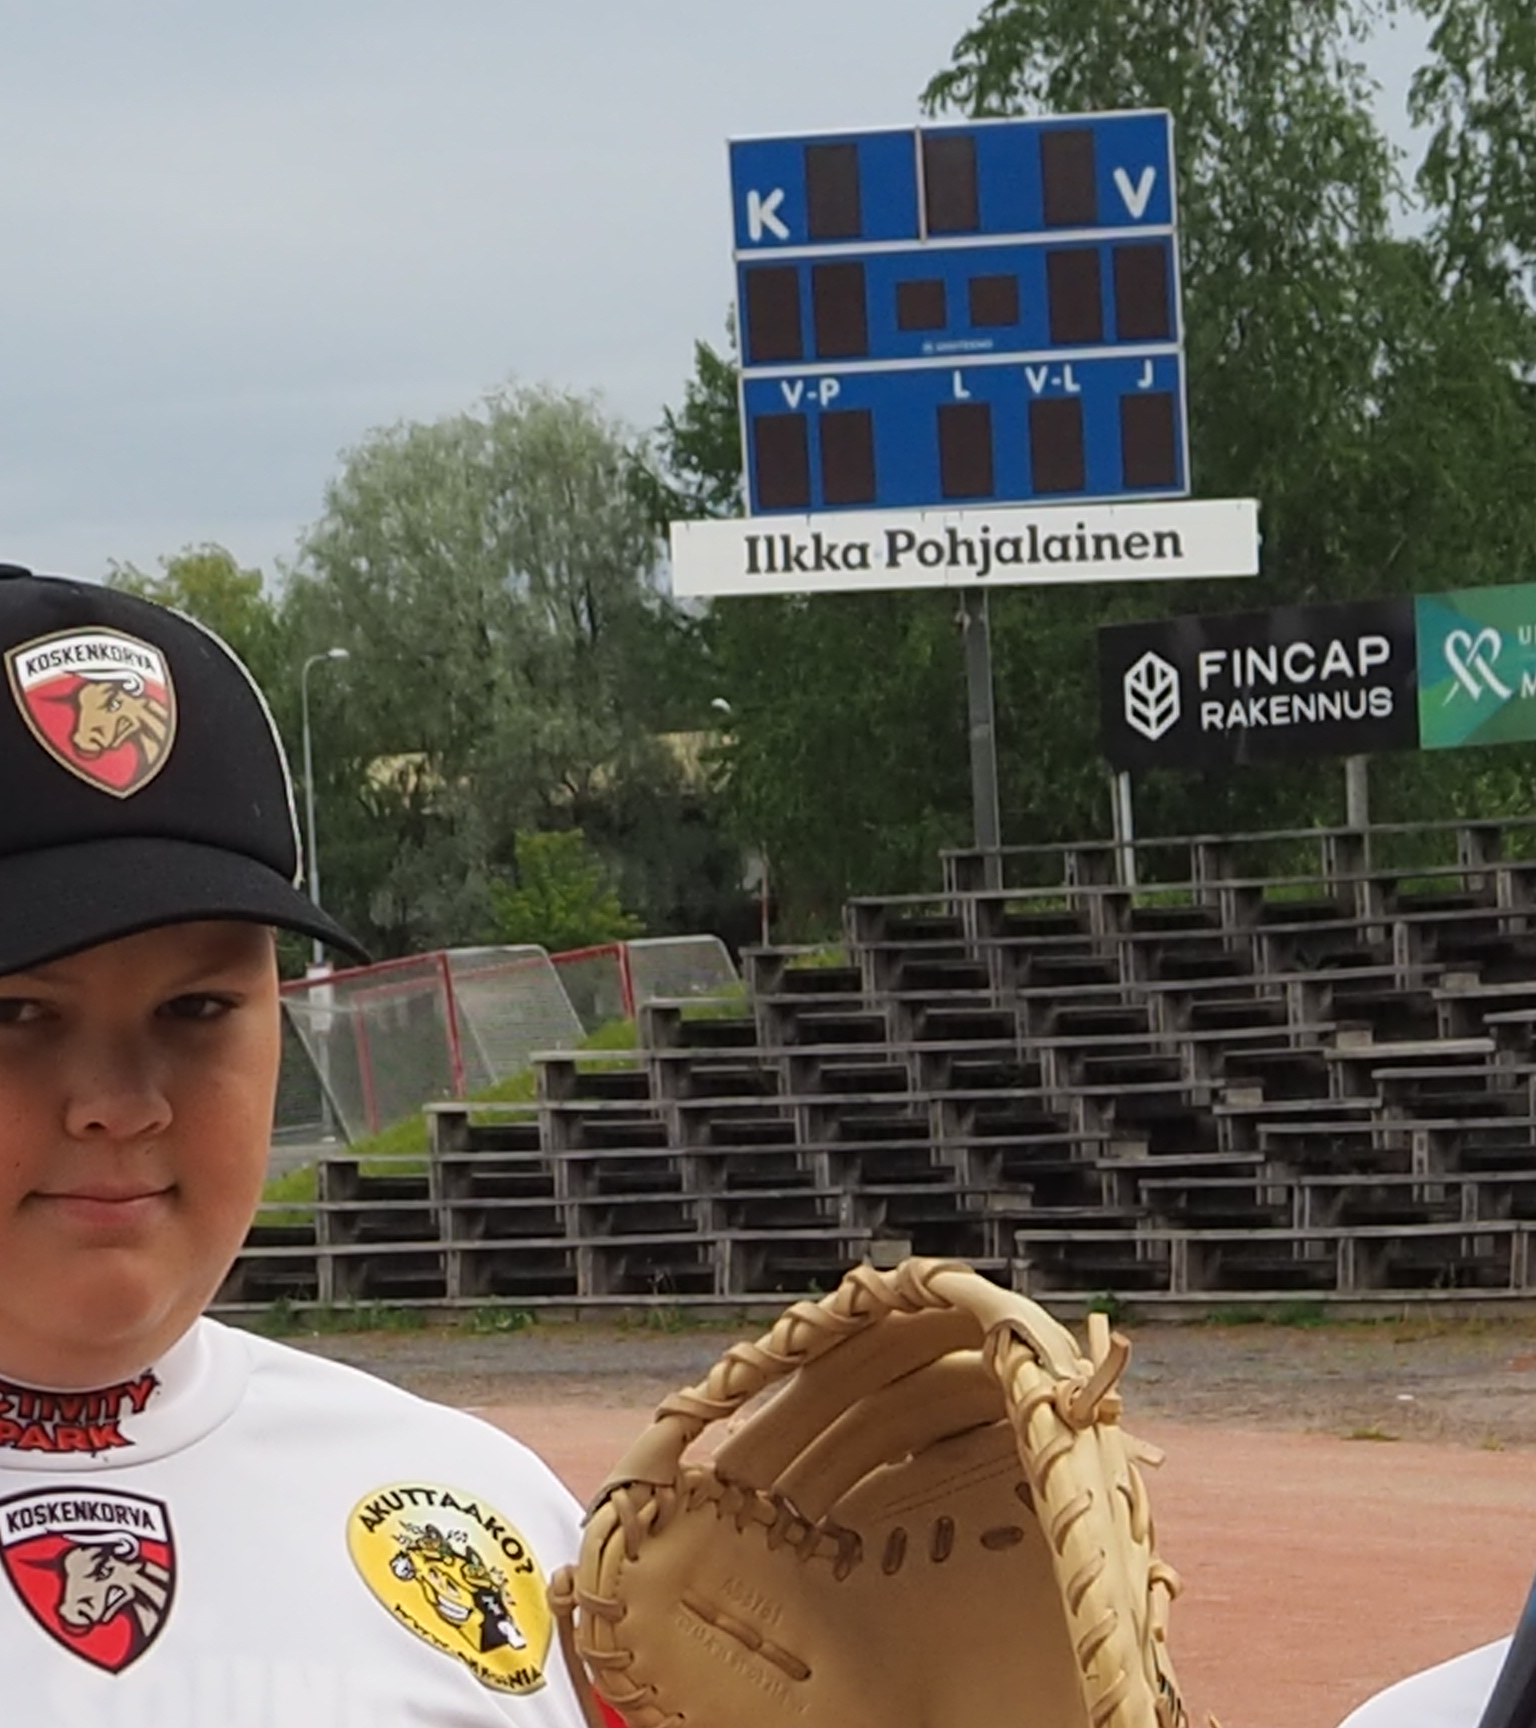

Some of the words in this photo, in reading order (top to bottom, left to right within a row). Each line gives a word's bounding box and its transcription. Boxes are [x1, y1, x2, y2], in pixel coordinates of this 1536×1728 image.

[1113, 166, 1156, 217] V
[746, 188, 789, 241] K
[953, 371, 970, 398] L
[1026, 365, 1080, 393] V-L
[1137, 360, 1153, 388] J
[781, 378, 840, 408] V-P
[744, 534, 870, 574] Ilkka
[884, 523, 1183, 576] Pohjalainen
[25, 643, 156, 677] KOSKENKORVA
[1199, 635, 1390, 691] FINCAP
[1200, 686, 1393, 732] RAKENNUS
[6, 1501, 155, 1533] KOSKENKORVA
